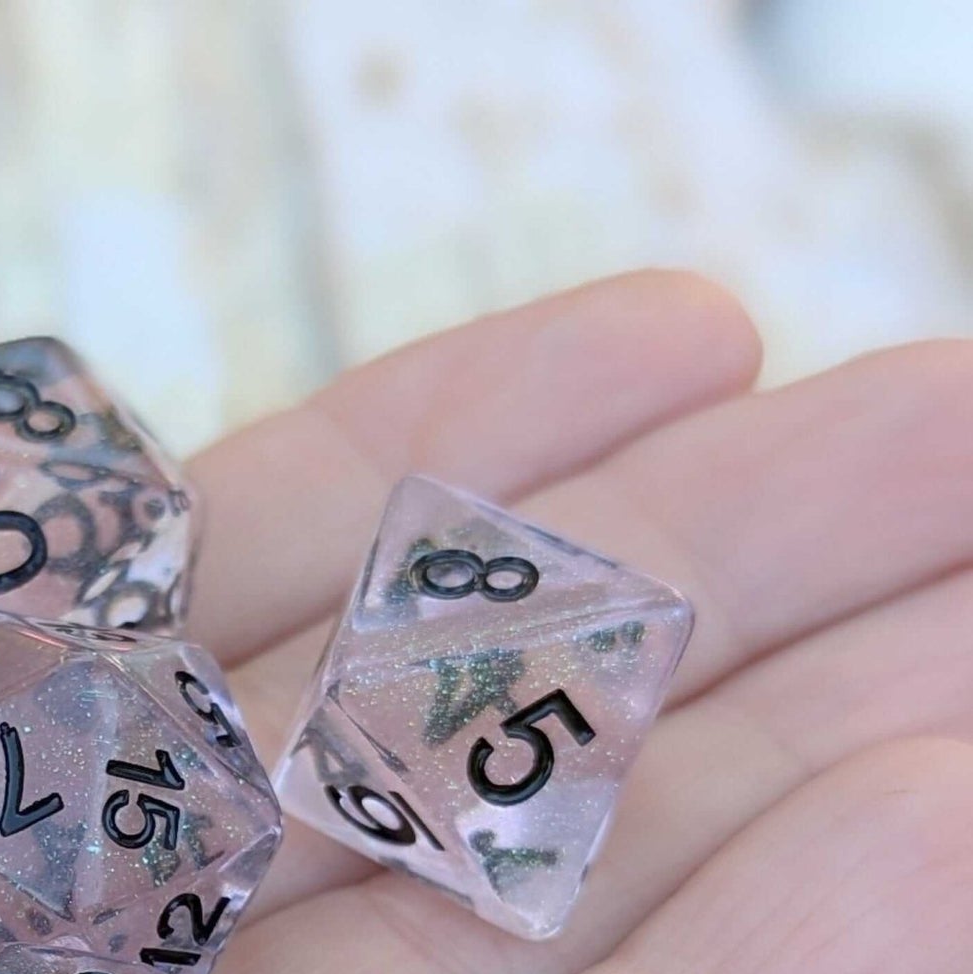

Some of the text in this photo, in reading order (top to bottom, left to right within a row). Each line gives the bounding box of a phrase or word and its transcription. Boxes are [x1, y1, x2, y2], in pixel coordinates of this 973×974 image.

[411, 549, 540, 603] 8
[467, 688, 597, 807] 5
[102, 749, 186, 850] 15
[139, 892, 233, 967] 12
